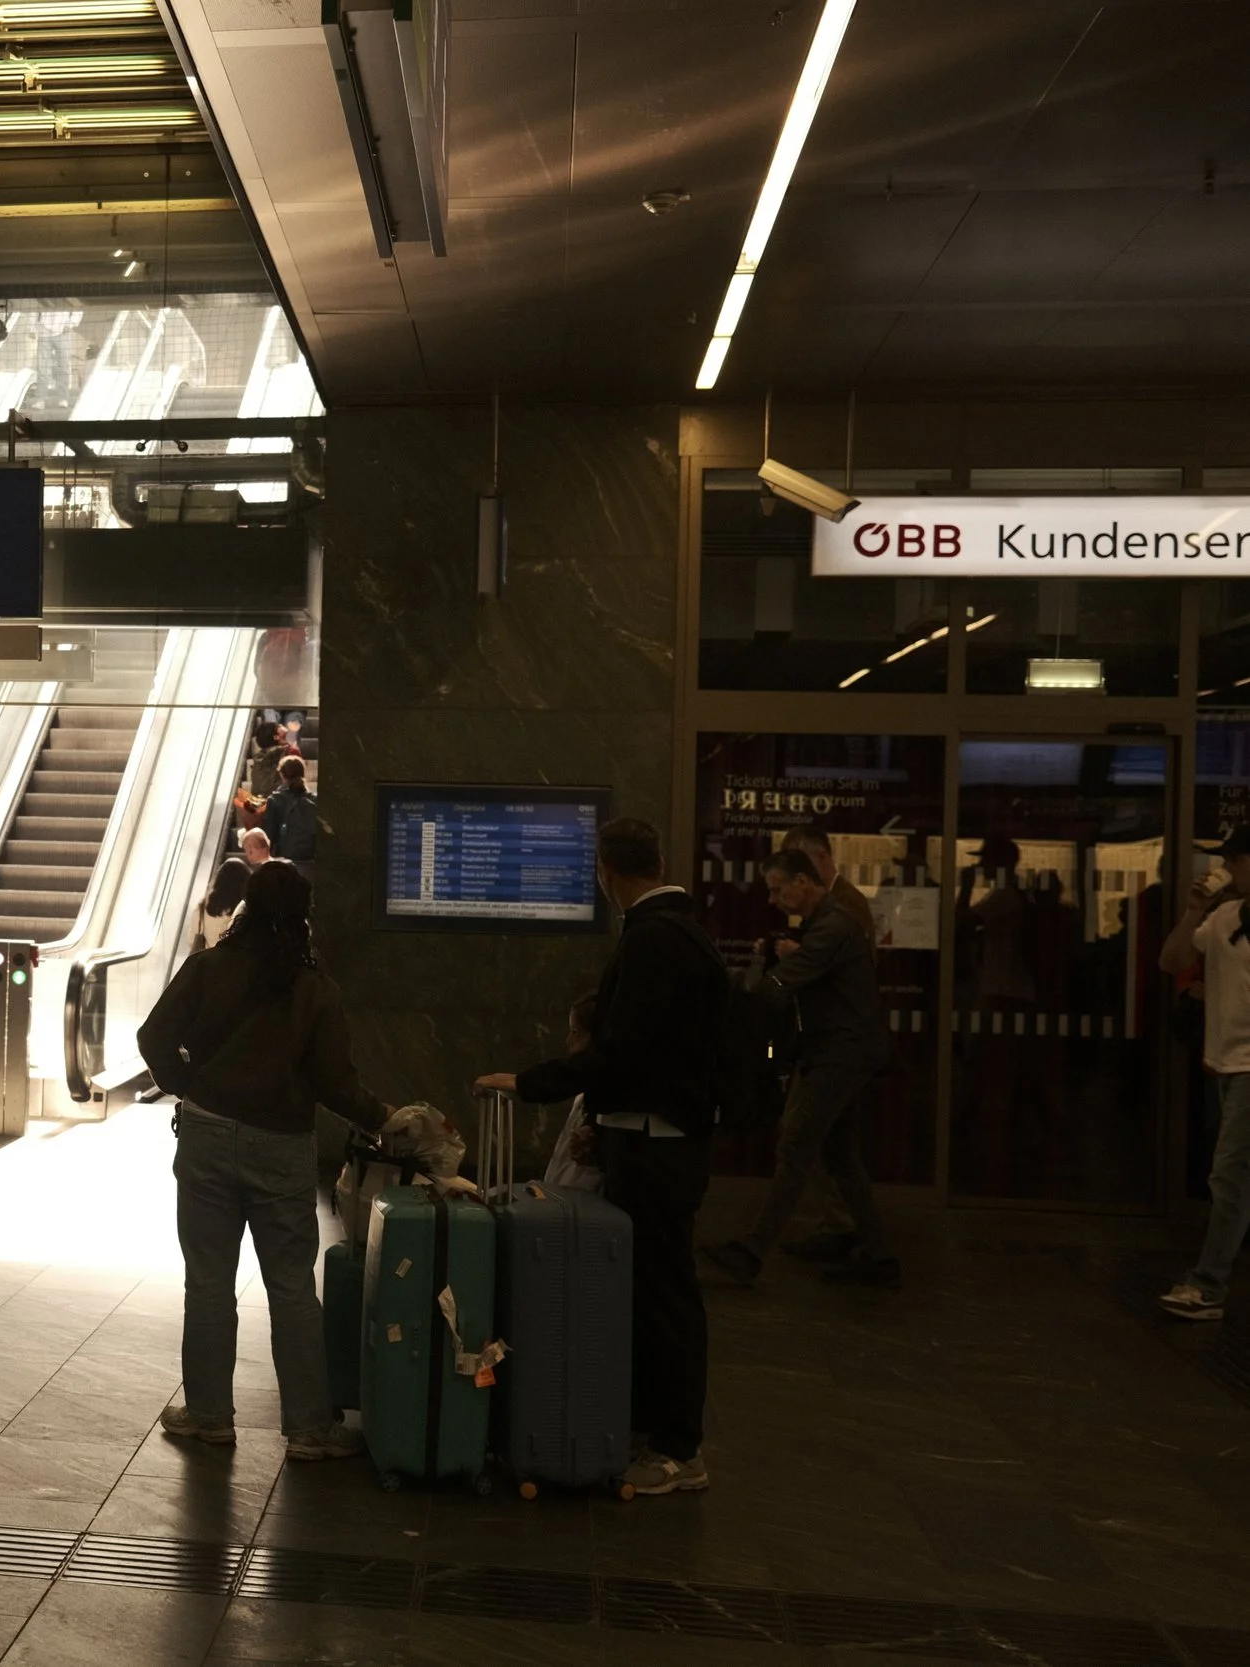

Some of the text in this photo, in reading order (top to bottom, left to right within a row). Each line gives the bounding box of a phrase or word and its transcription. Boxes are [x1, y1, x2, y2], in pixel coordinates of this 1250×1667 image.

[852, 521, 1250, 559] ÖBB Kundenser
[725, 774, 881, 791] Tickets erhalten Sie im
